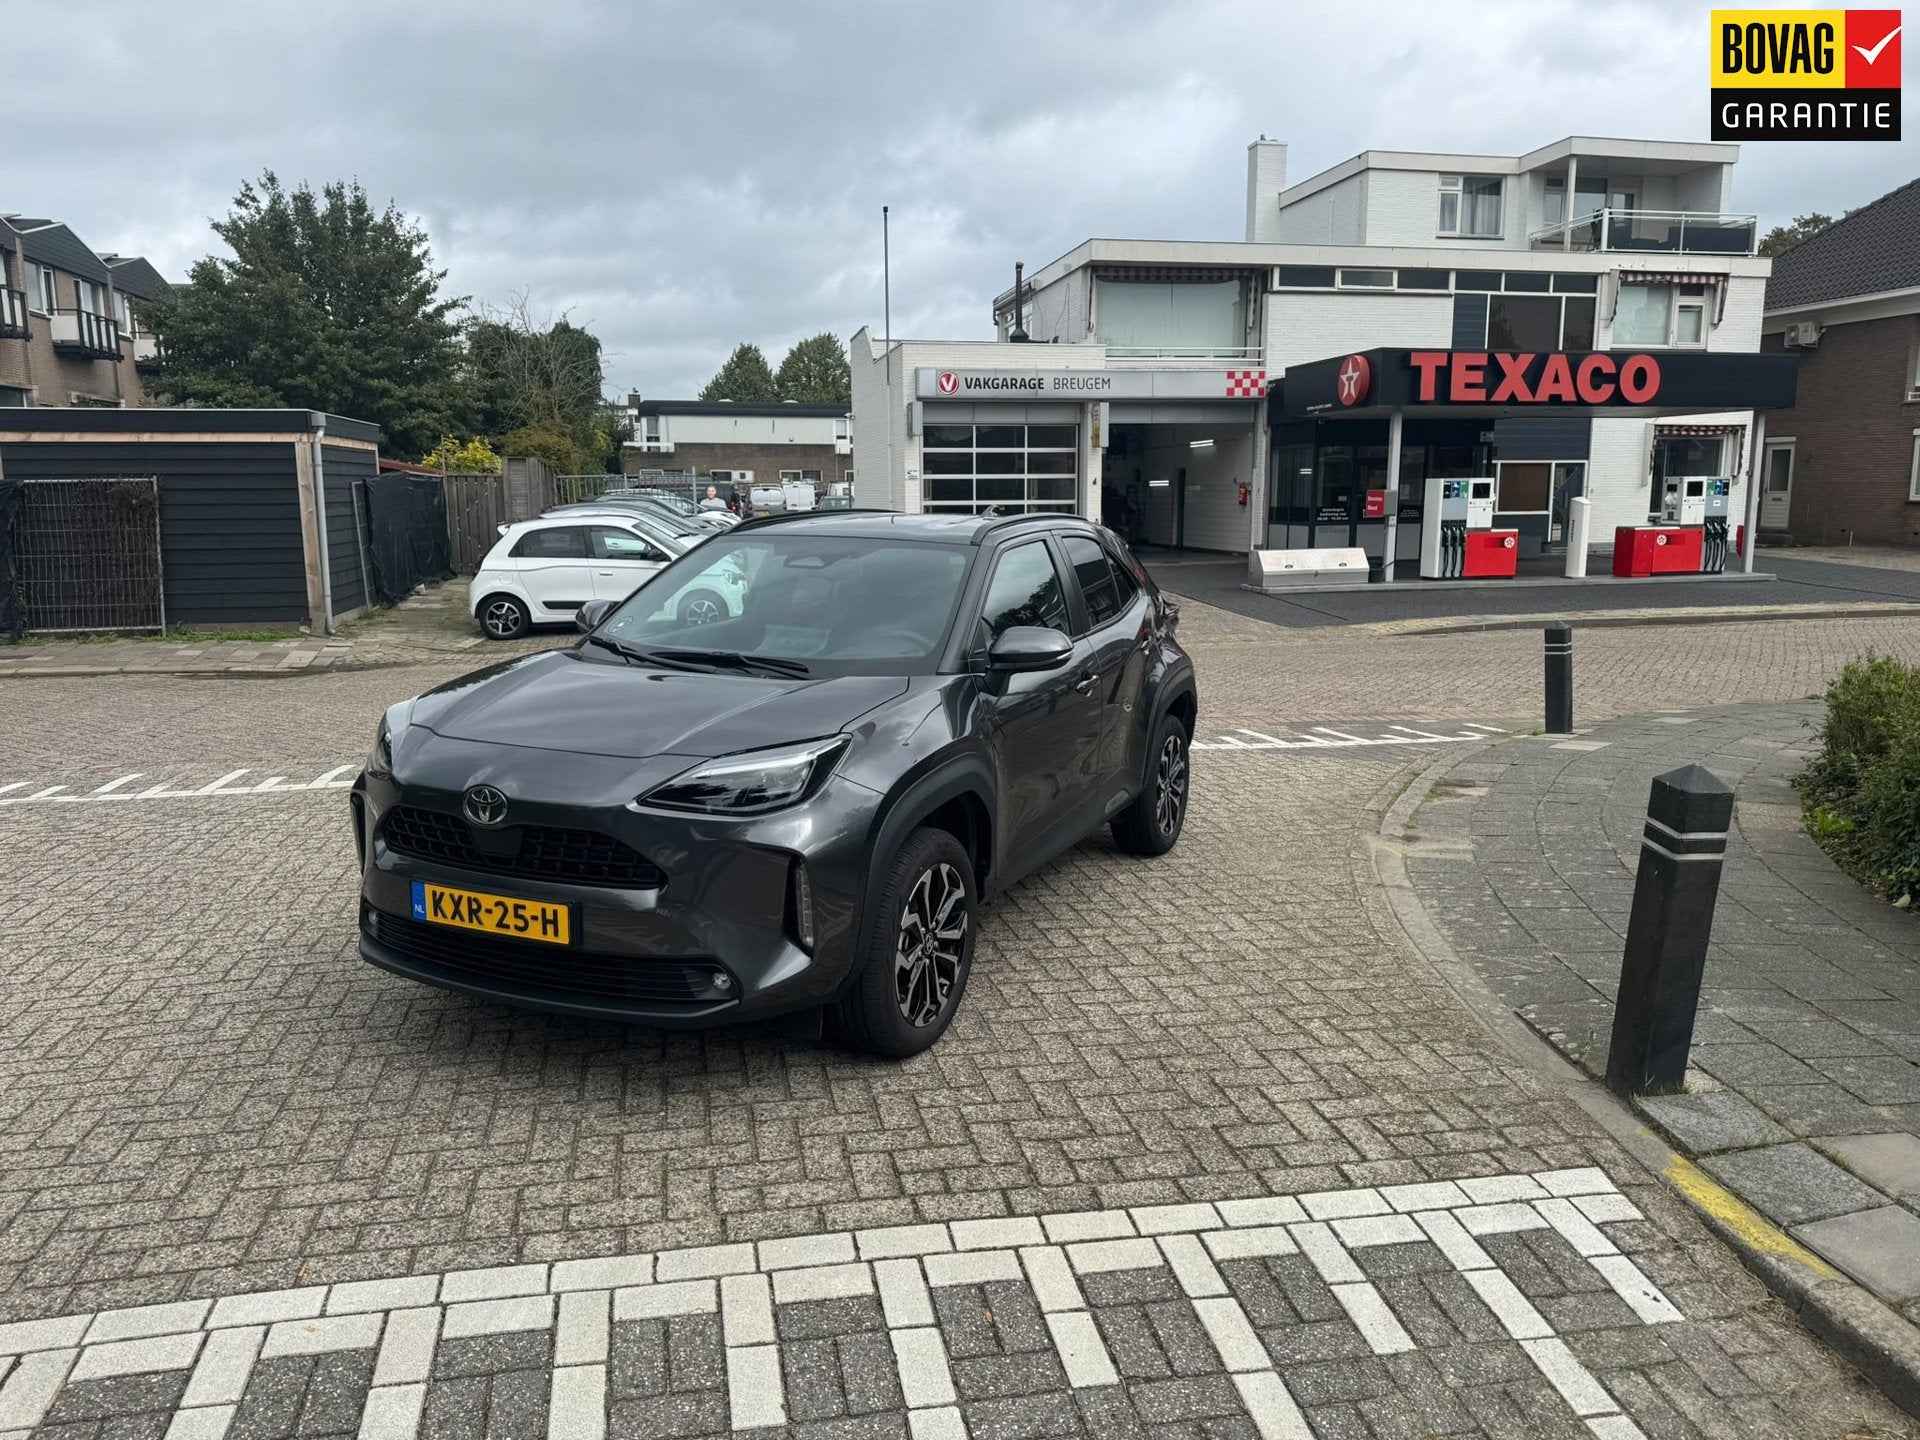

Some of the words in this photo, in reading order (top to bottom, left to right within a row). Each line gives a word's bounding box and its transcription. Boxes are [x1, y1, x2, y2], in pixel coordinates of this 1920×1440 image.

[964, 377, 1045, 390] VAKGARAGE
[1053, 377, 1111, 390] BREUGEM
[1411, 352, 1661, 404] TEXACO
[414, 903, 425, 914] NL
[431, 889, 560, 938] KXR-25-H
